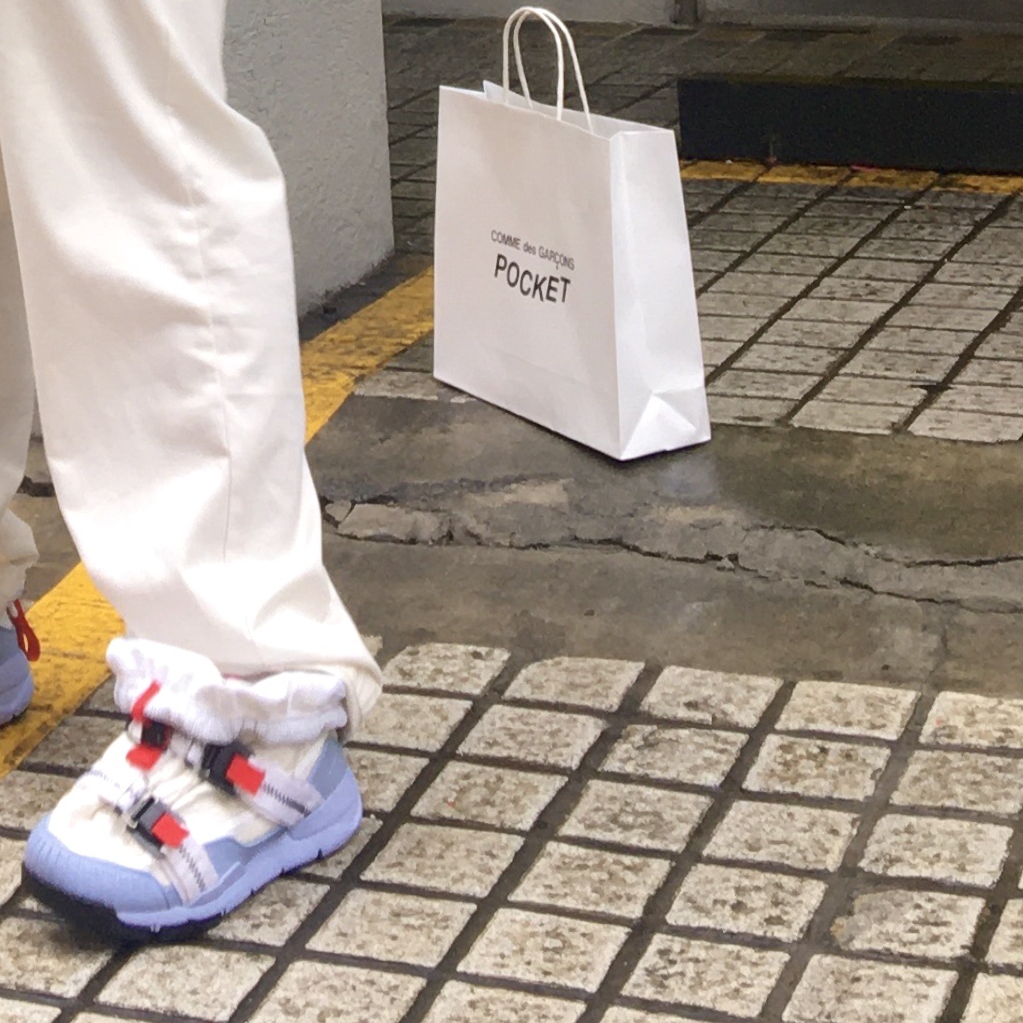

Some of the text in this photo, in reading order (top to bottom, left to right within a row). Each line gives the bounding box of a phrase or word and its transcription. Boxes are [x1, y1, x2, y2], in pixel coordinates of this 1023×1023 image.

[491, 229, 575, 271] COMME des GARÇONS
[494, 253, 571, 303] POCKET
